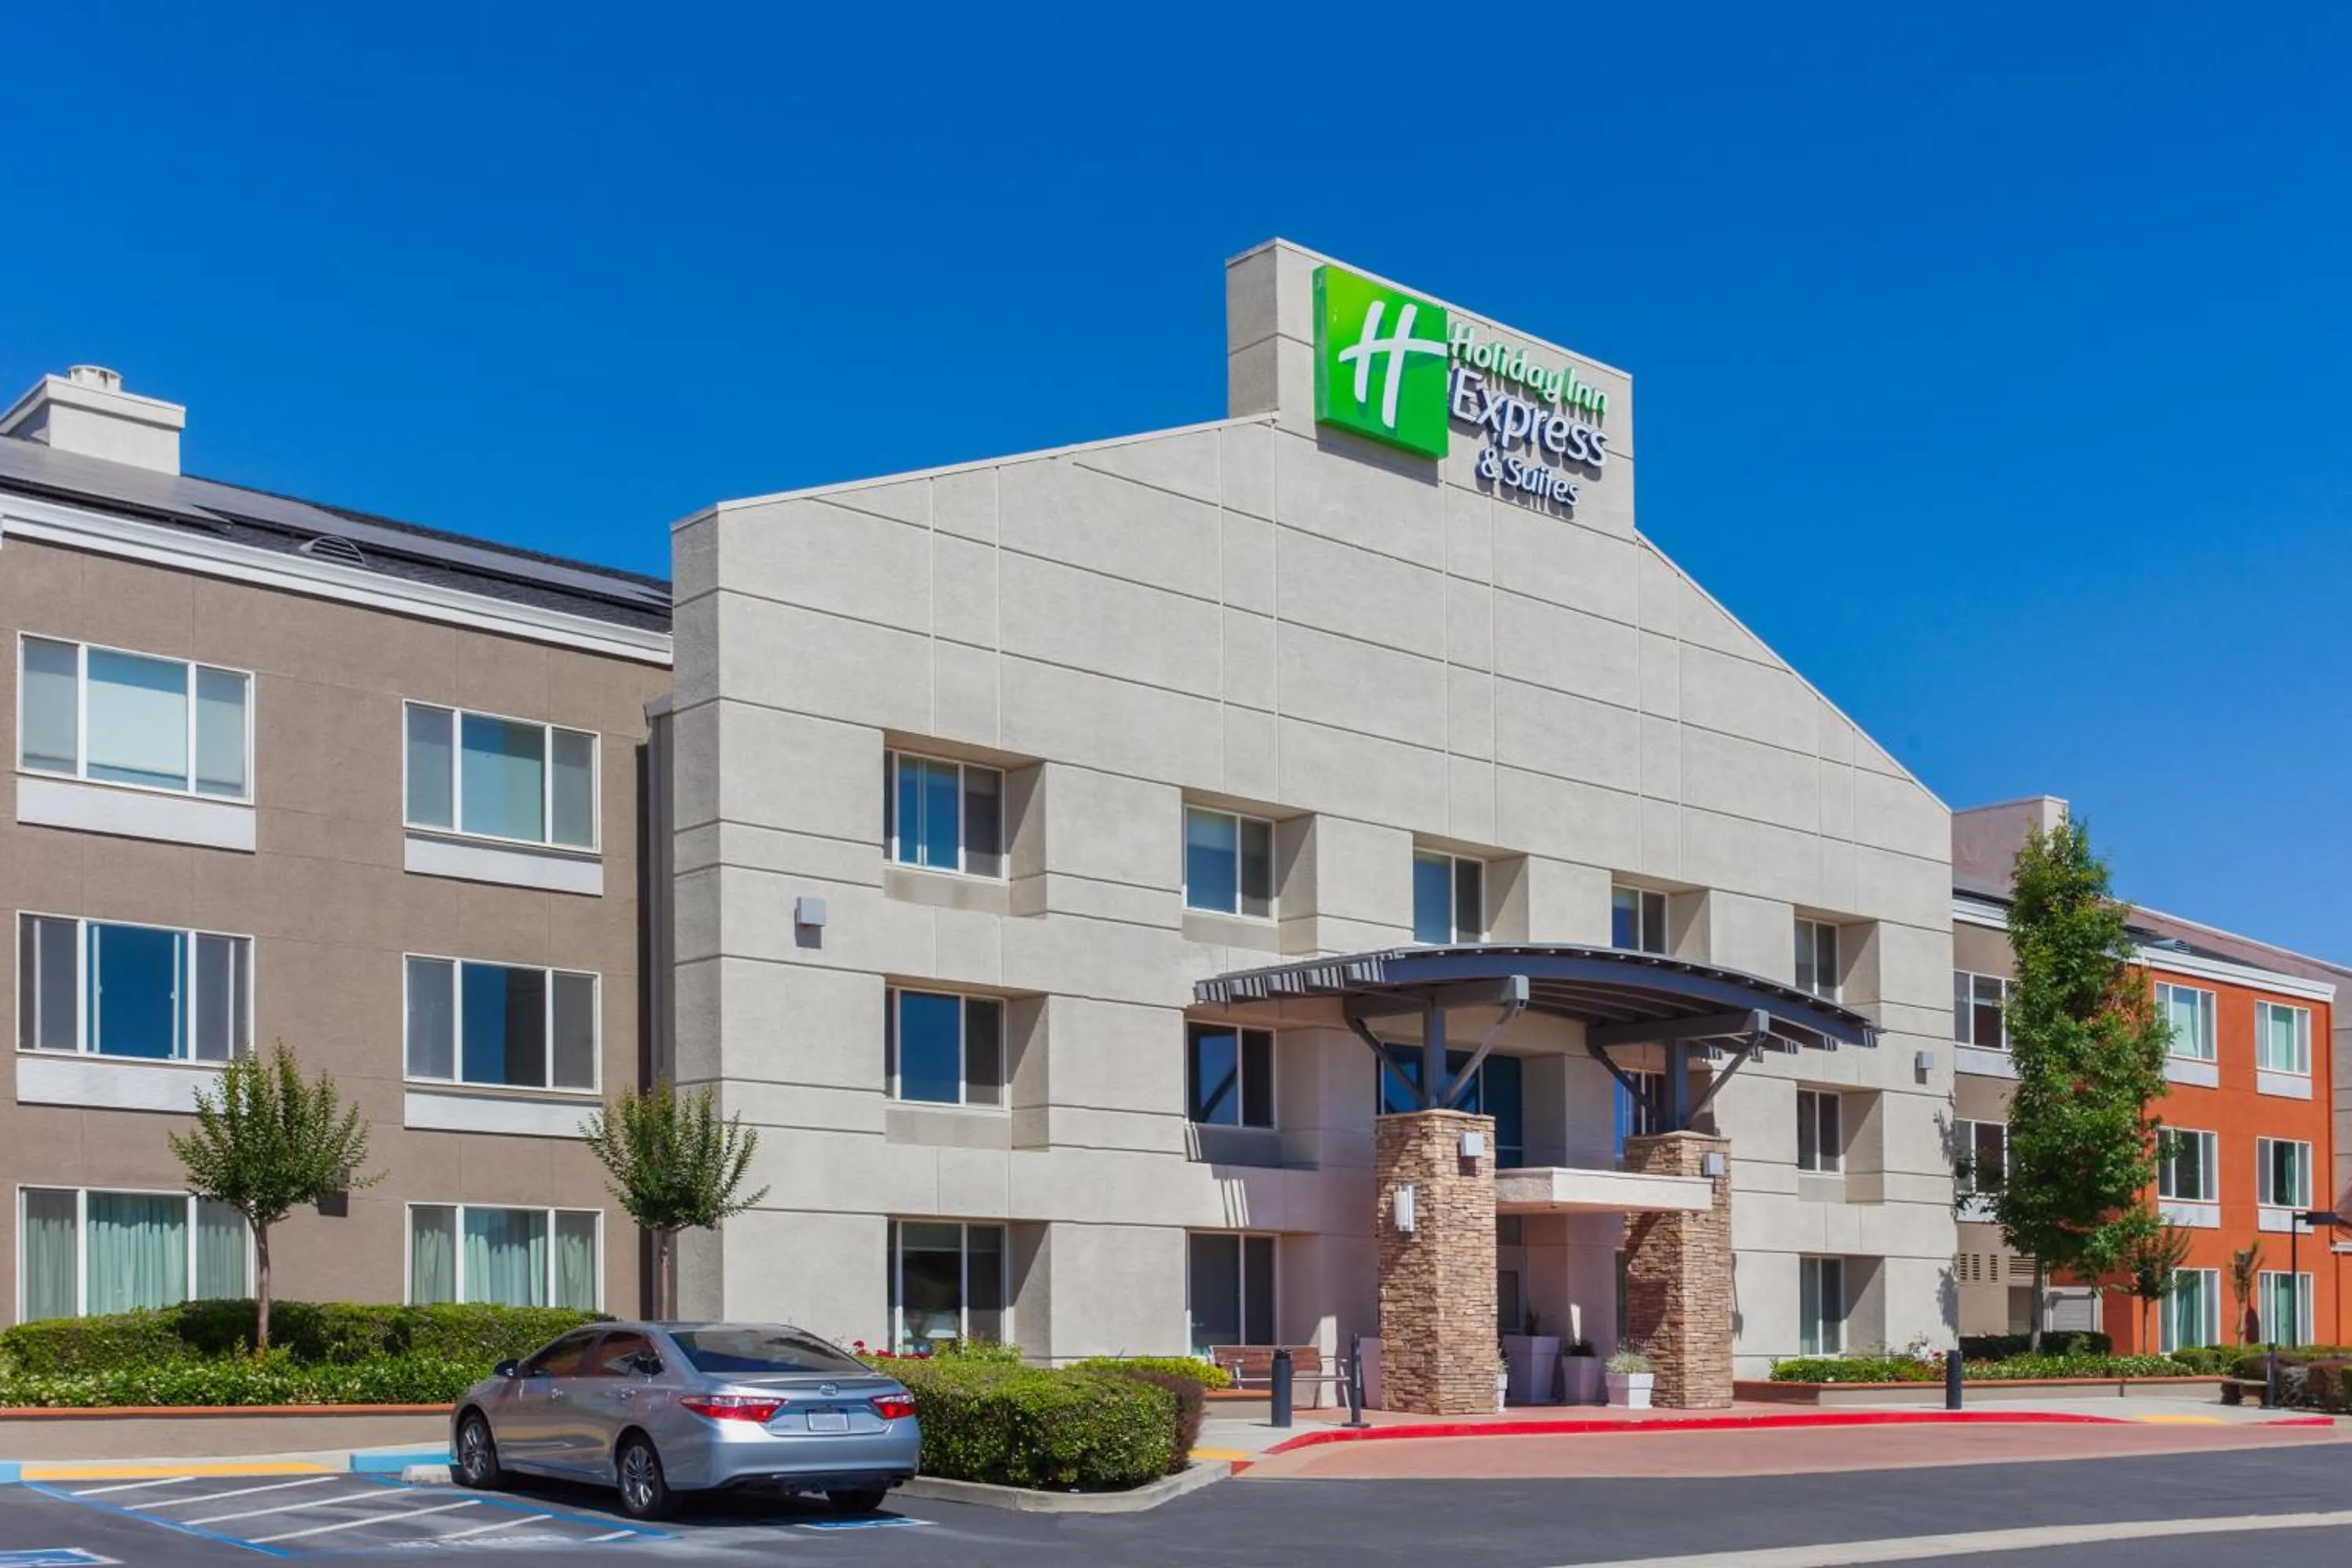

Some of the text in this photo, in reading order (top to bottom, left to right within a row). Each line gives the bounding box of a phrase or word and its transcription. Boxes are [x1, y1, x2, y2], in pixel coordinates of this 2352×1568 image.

[1338, 300, 1448, 429] H
[1450, 321, 1609, 413] Holiday Inn
[1450, 367, 1609, 467] Express
[1478, 446, 1580, 506] & Suites
